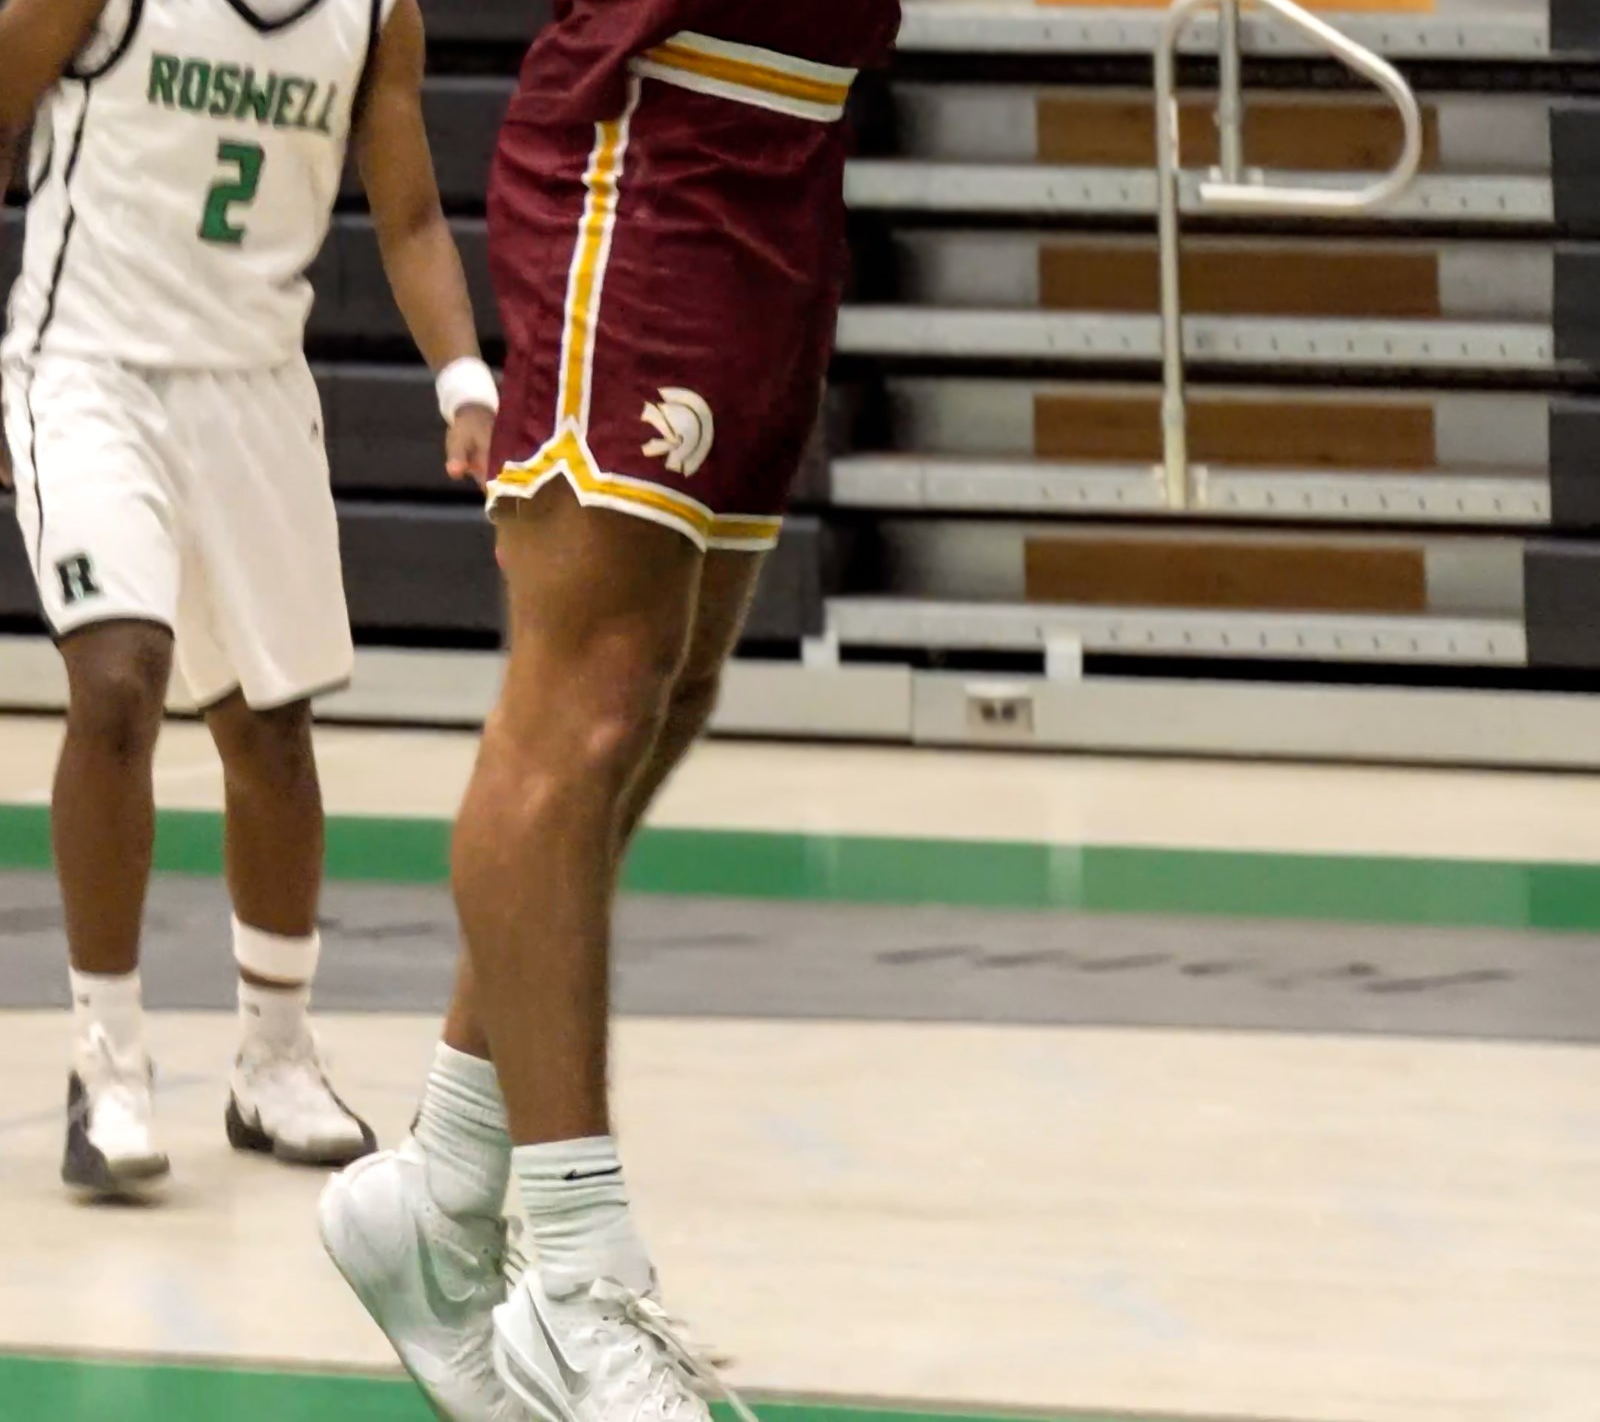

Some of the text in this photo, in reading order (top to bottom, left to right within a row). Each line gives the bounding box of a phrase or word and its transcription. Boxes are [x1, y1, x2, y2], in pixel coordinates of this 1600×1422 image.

[147, 51, 337, 136] ROSWELL
[197, 138, 266, 247] 2
[54, 551, 100, 606] R
